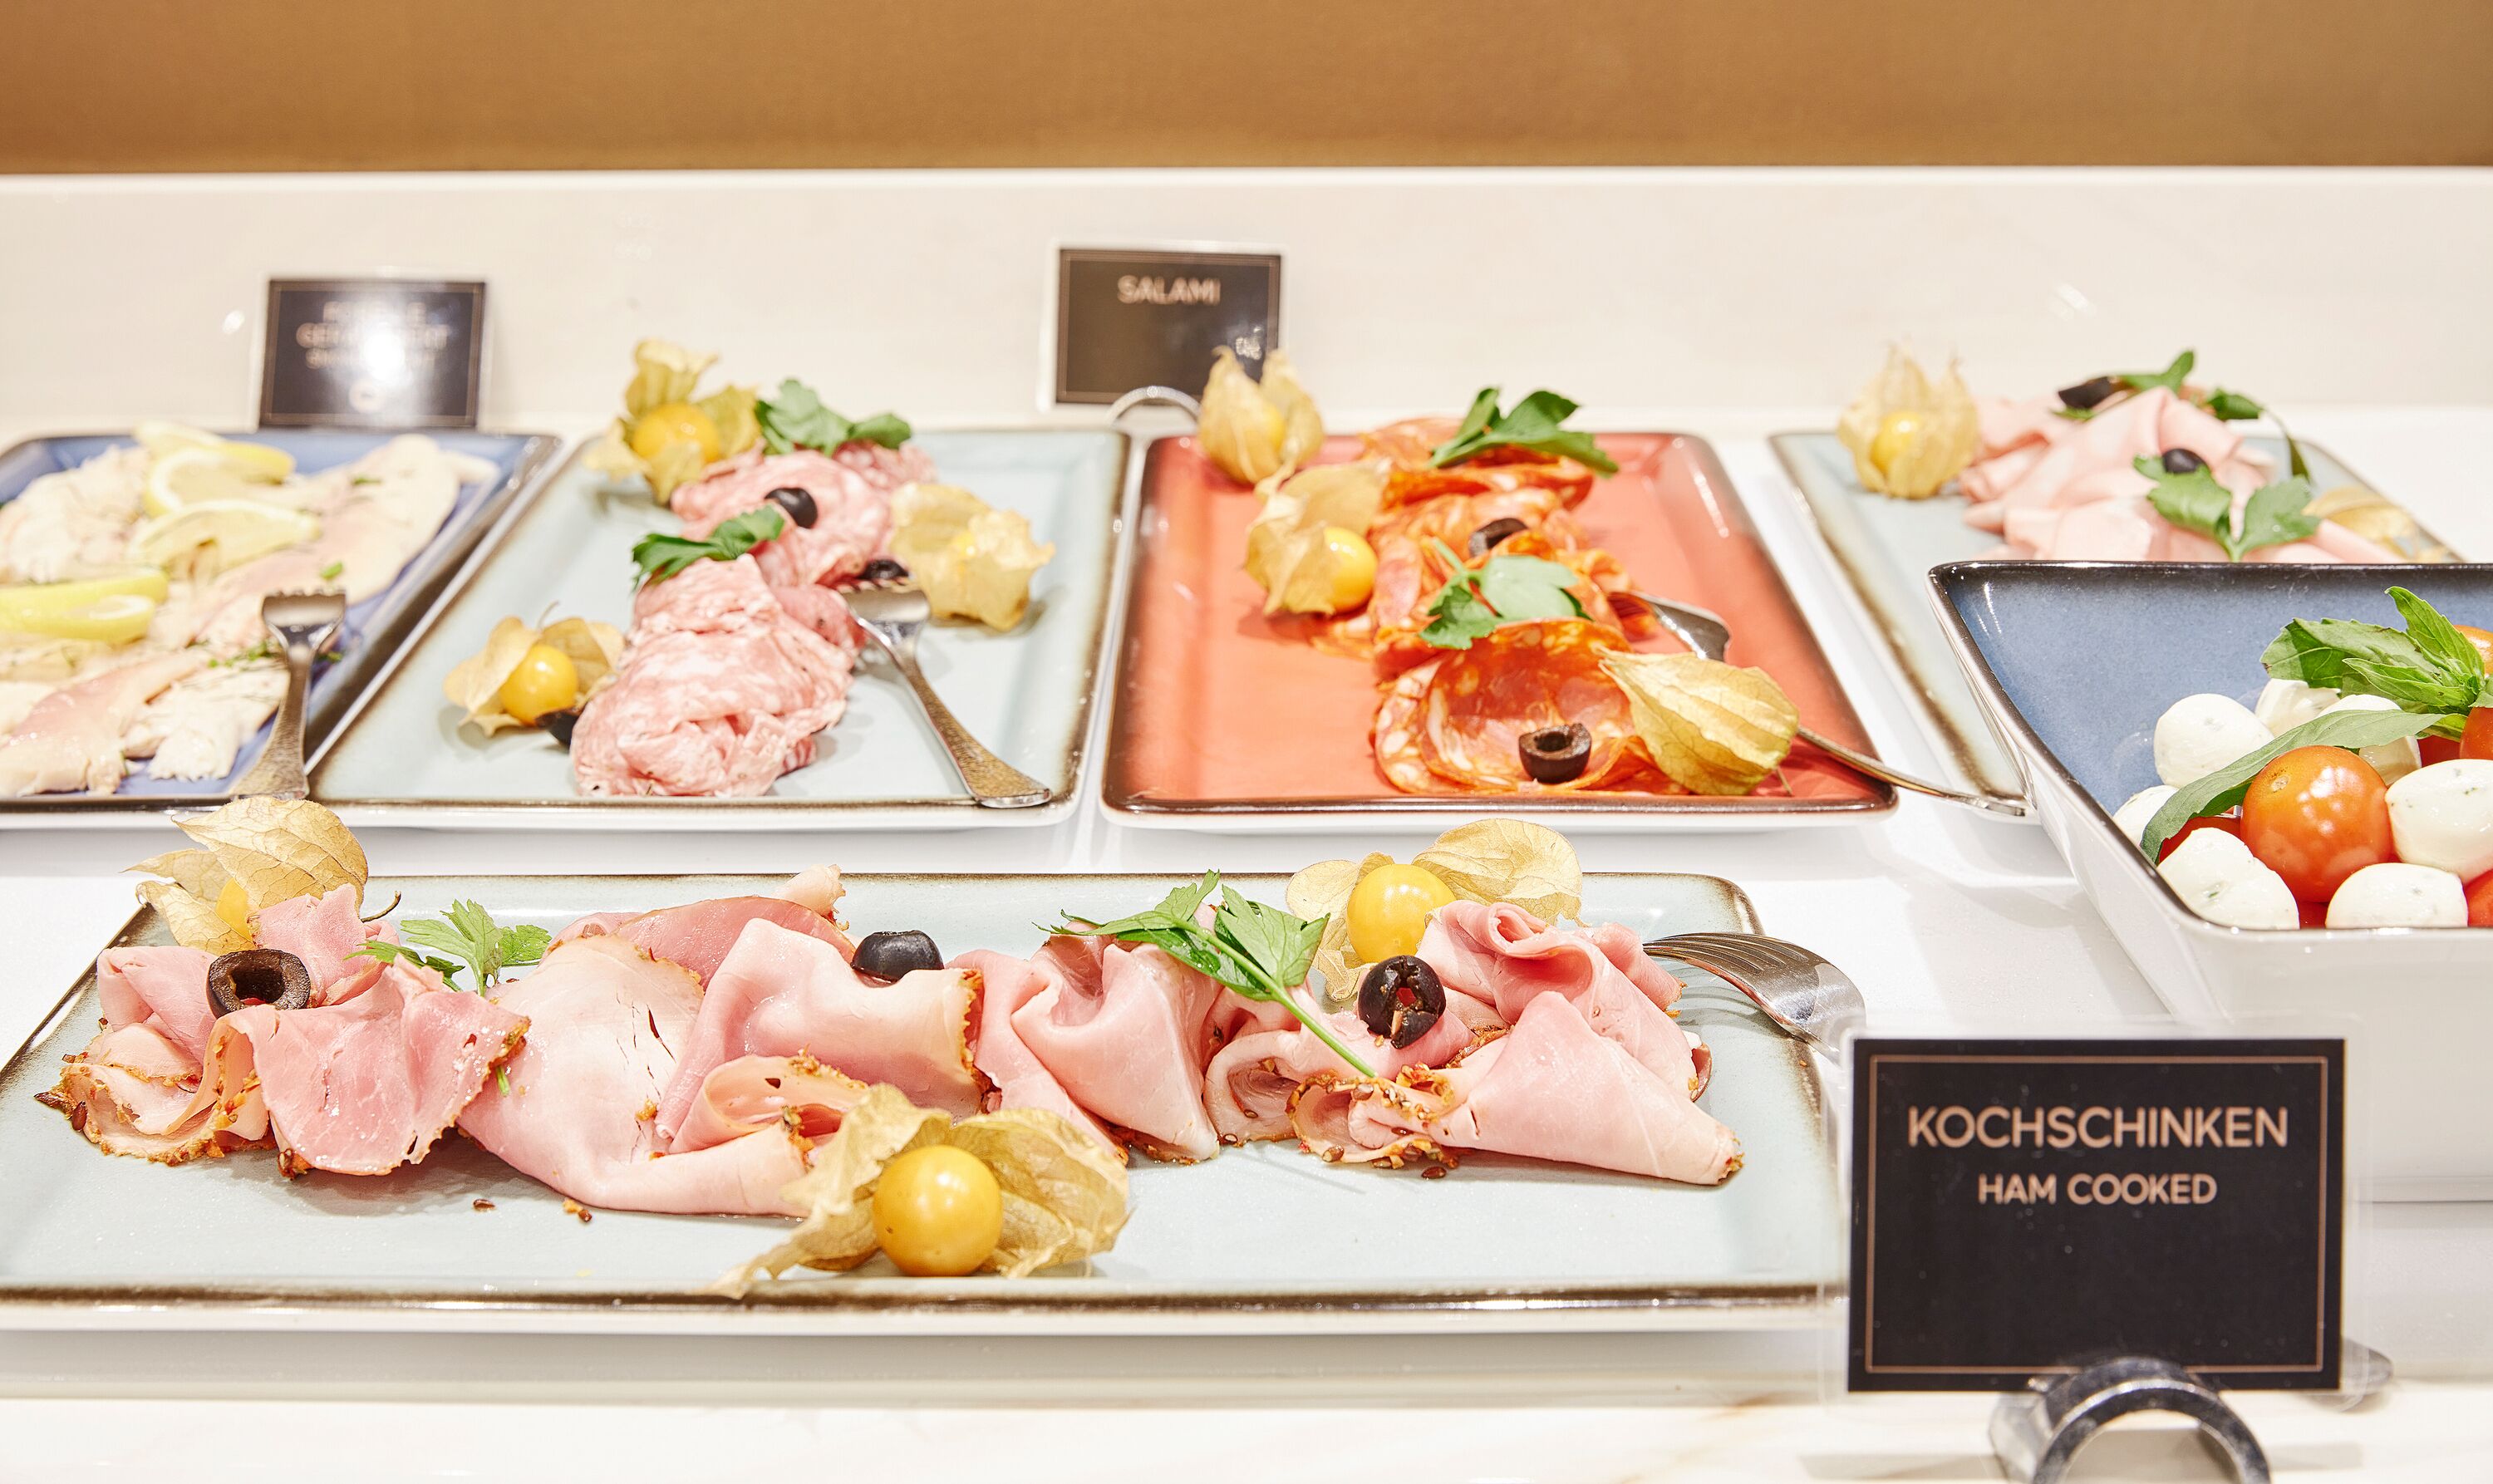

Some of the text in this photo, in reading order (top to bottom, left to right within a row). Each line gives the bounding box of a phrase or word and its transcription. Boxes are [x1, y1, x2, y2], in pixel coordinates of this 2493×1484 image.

[1118, 275, 1221, 305] SALAMI
[1908, 1106, 2289, 1147] KOCHSCHINKEN
[1979, 1174, 2217, 1205] HAM COOKED
